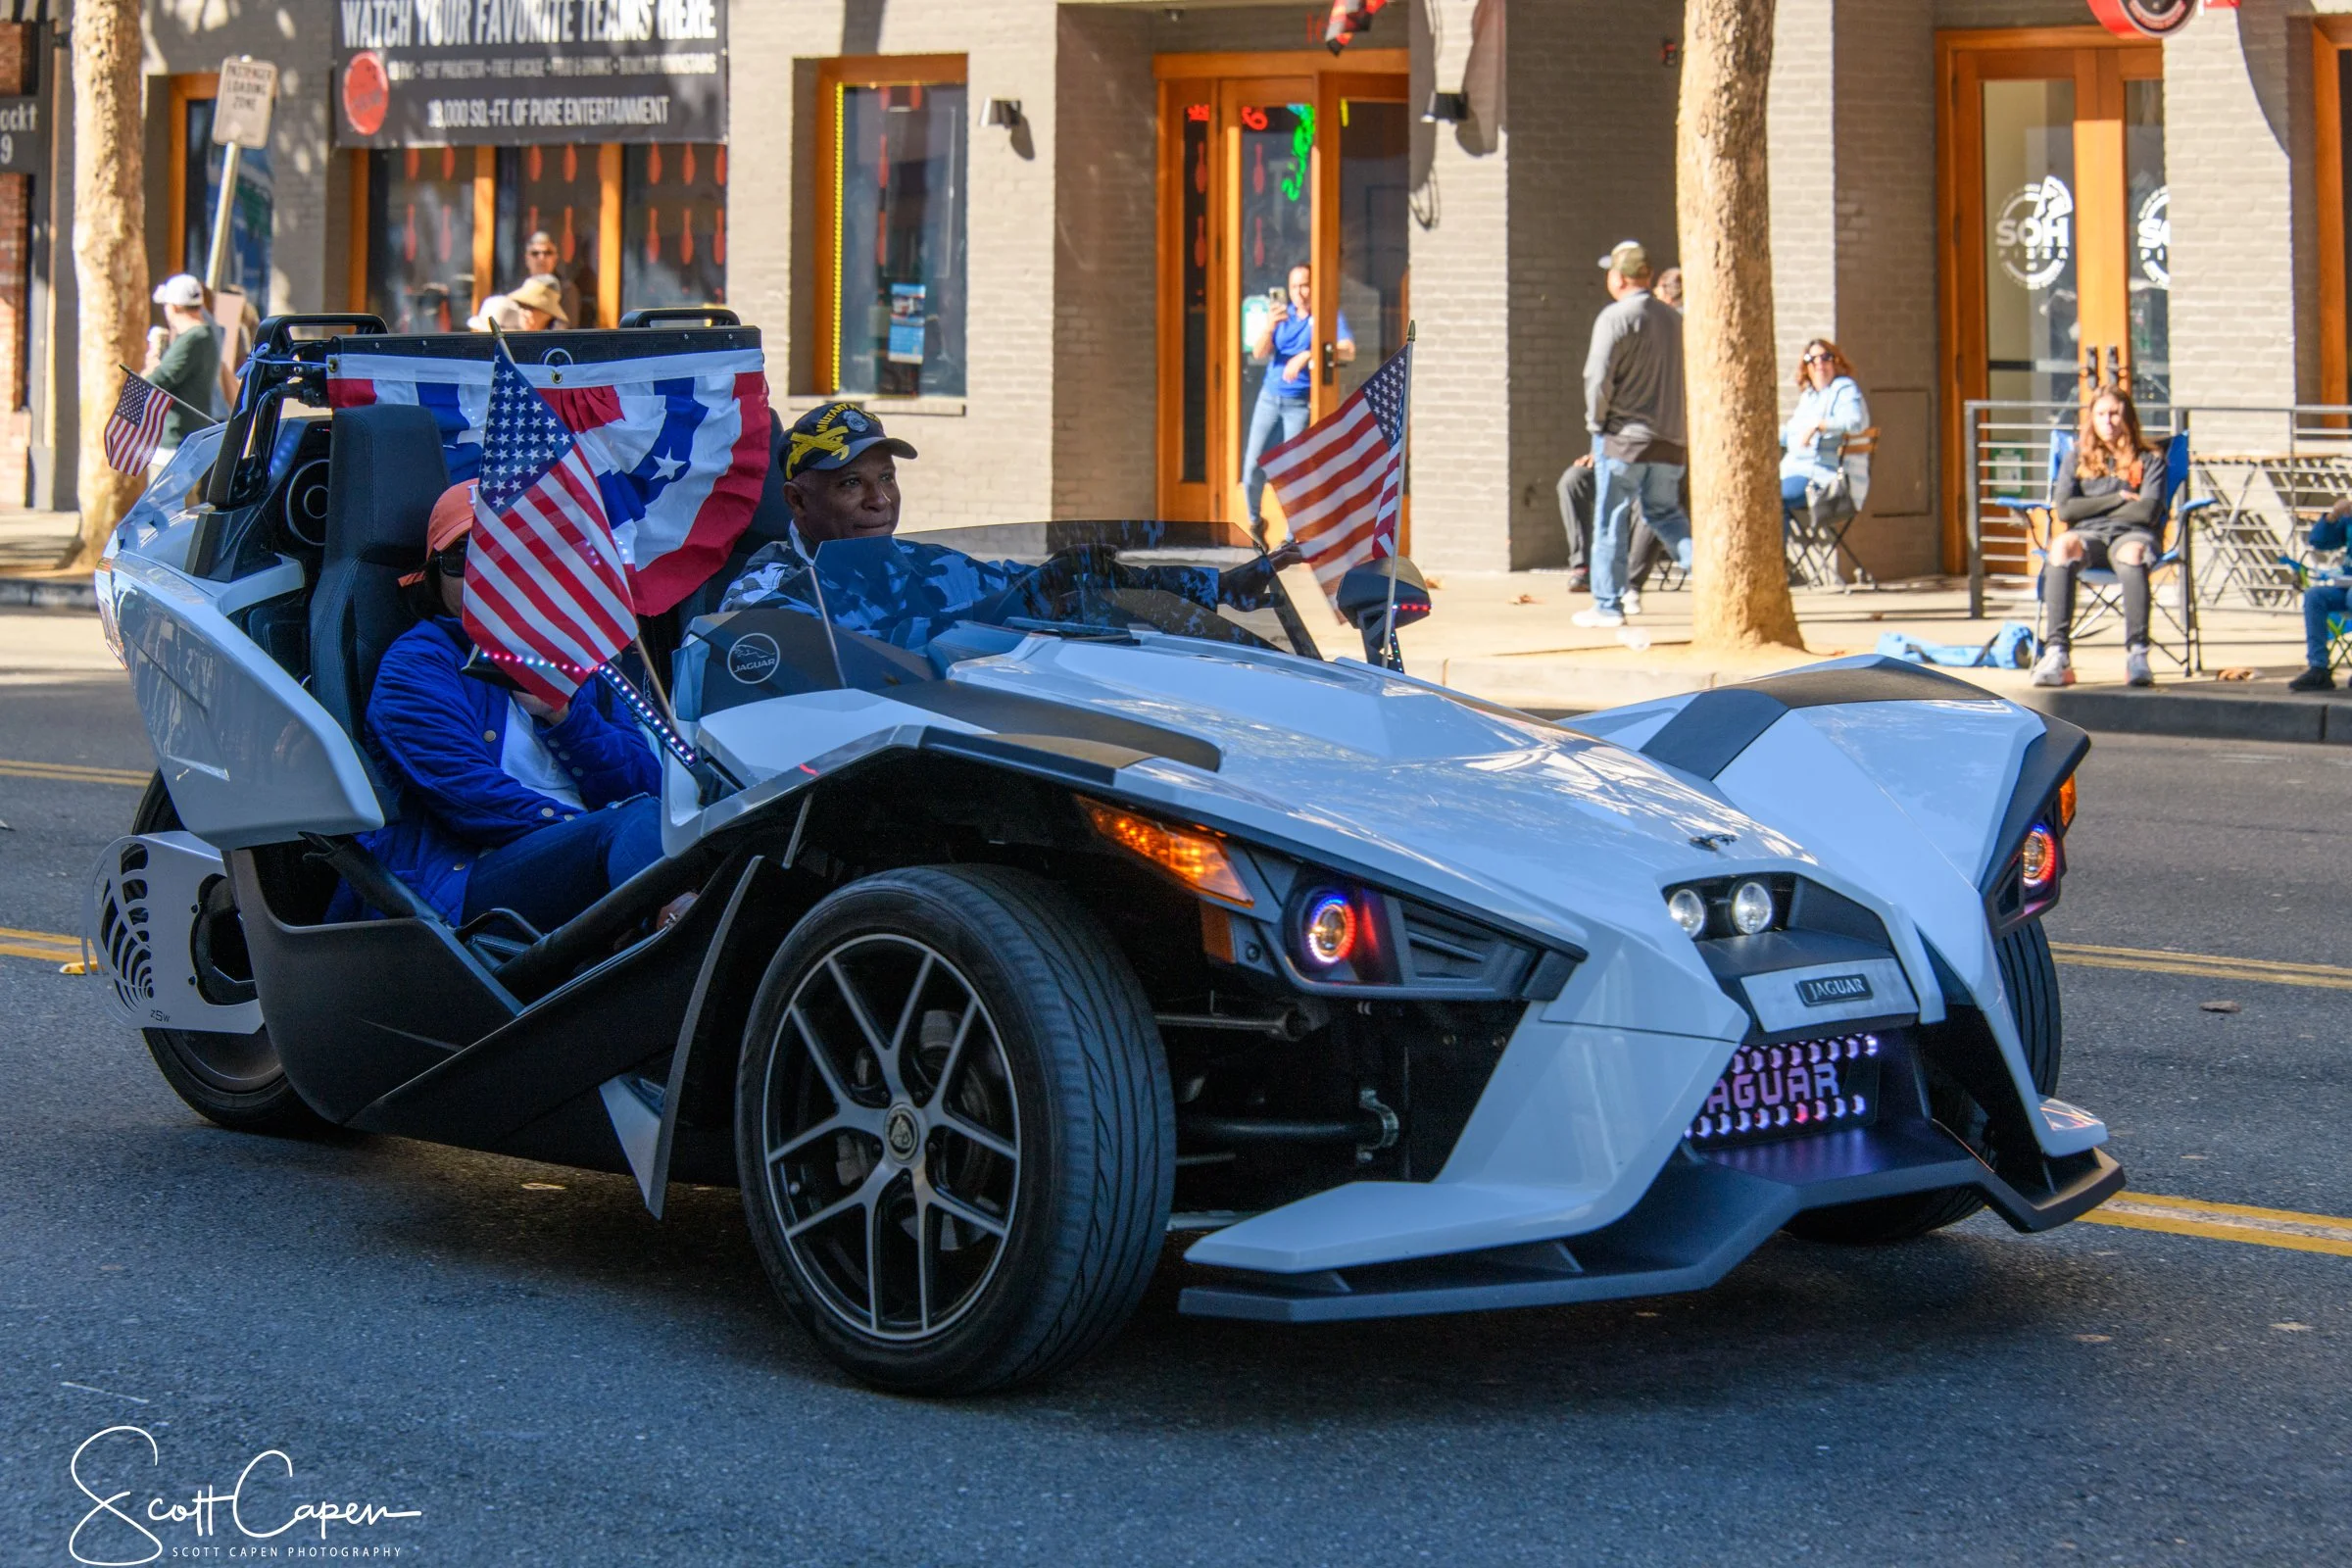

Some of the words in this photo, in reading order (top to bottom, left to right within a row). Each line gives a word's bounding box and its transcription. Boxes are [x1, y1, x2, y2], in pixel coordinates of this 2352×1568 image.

[342, 0, 414, 48] WATCH
[416, 0, 472, 46] YOUR
[474, 0, 575, 44] FAVORITE
[581, 0, 655, 41] TEAMS
[658, 0, 717, 40] HERE
[225, 79, 268, 96] LOADING
[231, 95, 257, 112] ZONE
[512, 98, 528, 126] OF
[529, 97, 564, 125] PURE
[564, 96, 670, 124] ENTERTAINMENT
[1995, 217, 2070, 248] SOH
[1997, 246, 2069, 261] PIZZA
[816, 403, 849, 432] MILITARY
[733, 658, 776, 673] JAGUAR
[1809, 977, 1866, 1002] JAGUAR
